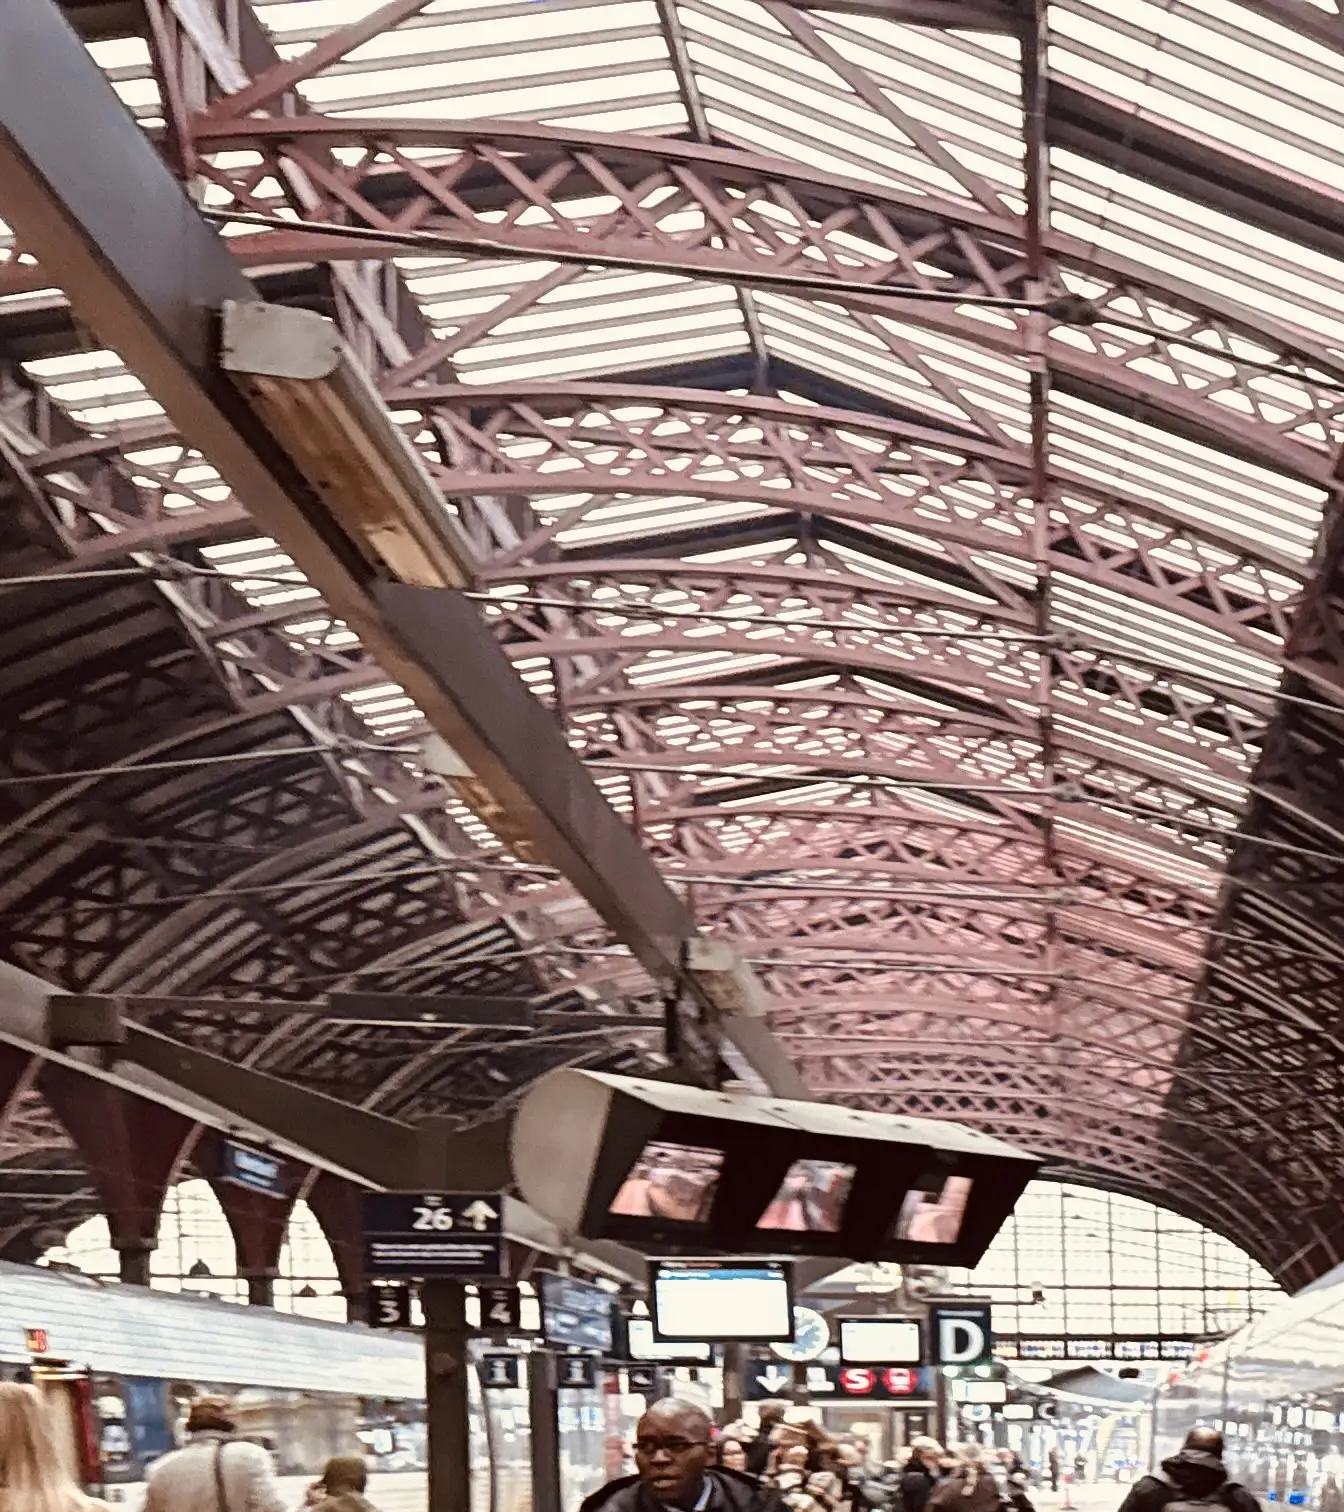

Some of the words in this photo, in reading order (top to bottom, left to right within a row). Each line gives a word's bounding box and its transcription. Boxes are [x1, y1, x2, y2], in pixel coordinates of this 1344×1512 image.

[412, 1207, 453, 1231] 26
[379, 1300, 400, 1323] 3
[488, 1303, 511, 1325] 4
[938, 1318, 985, 1363] D
[843, 1368, 872, 1390] S
